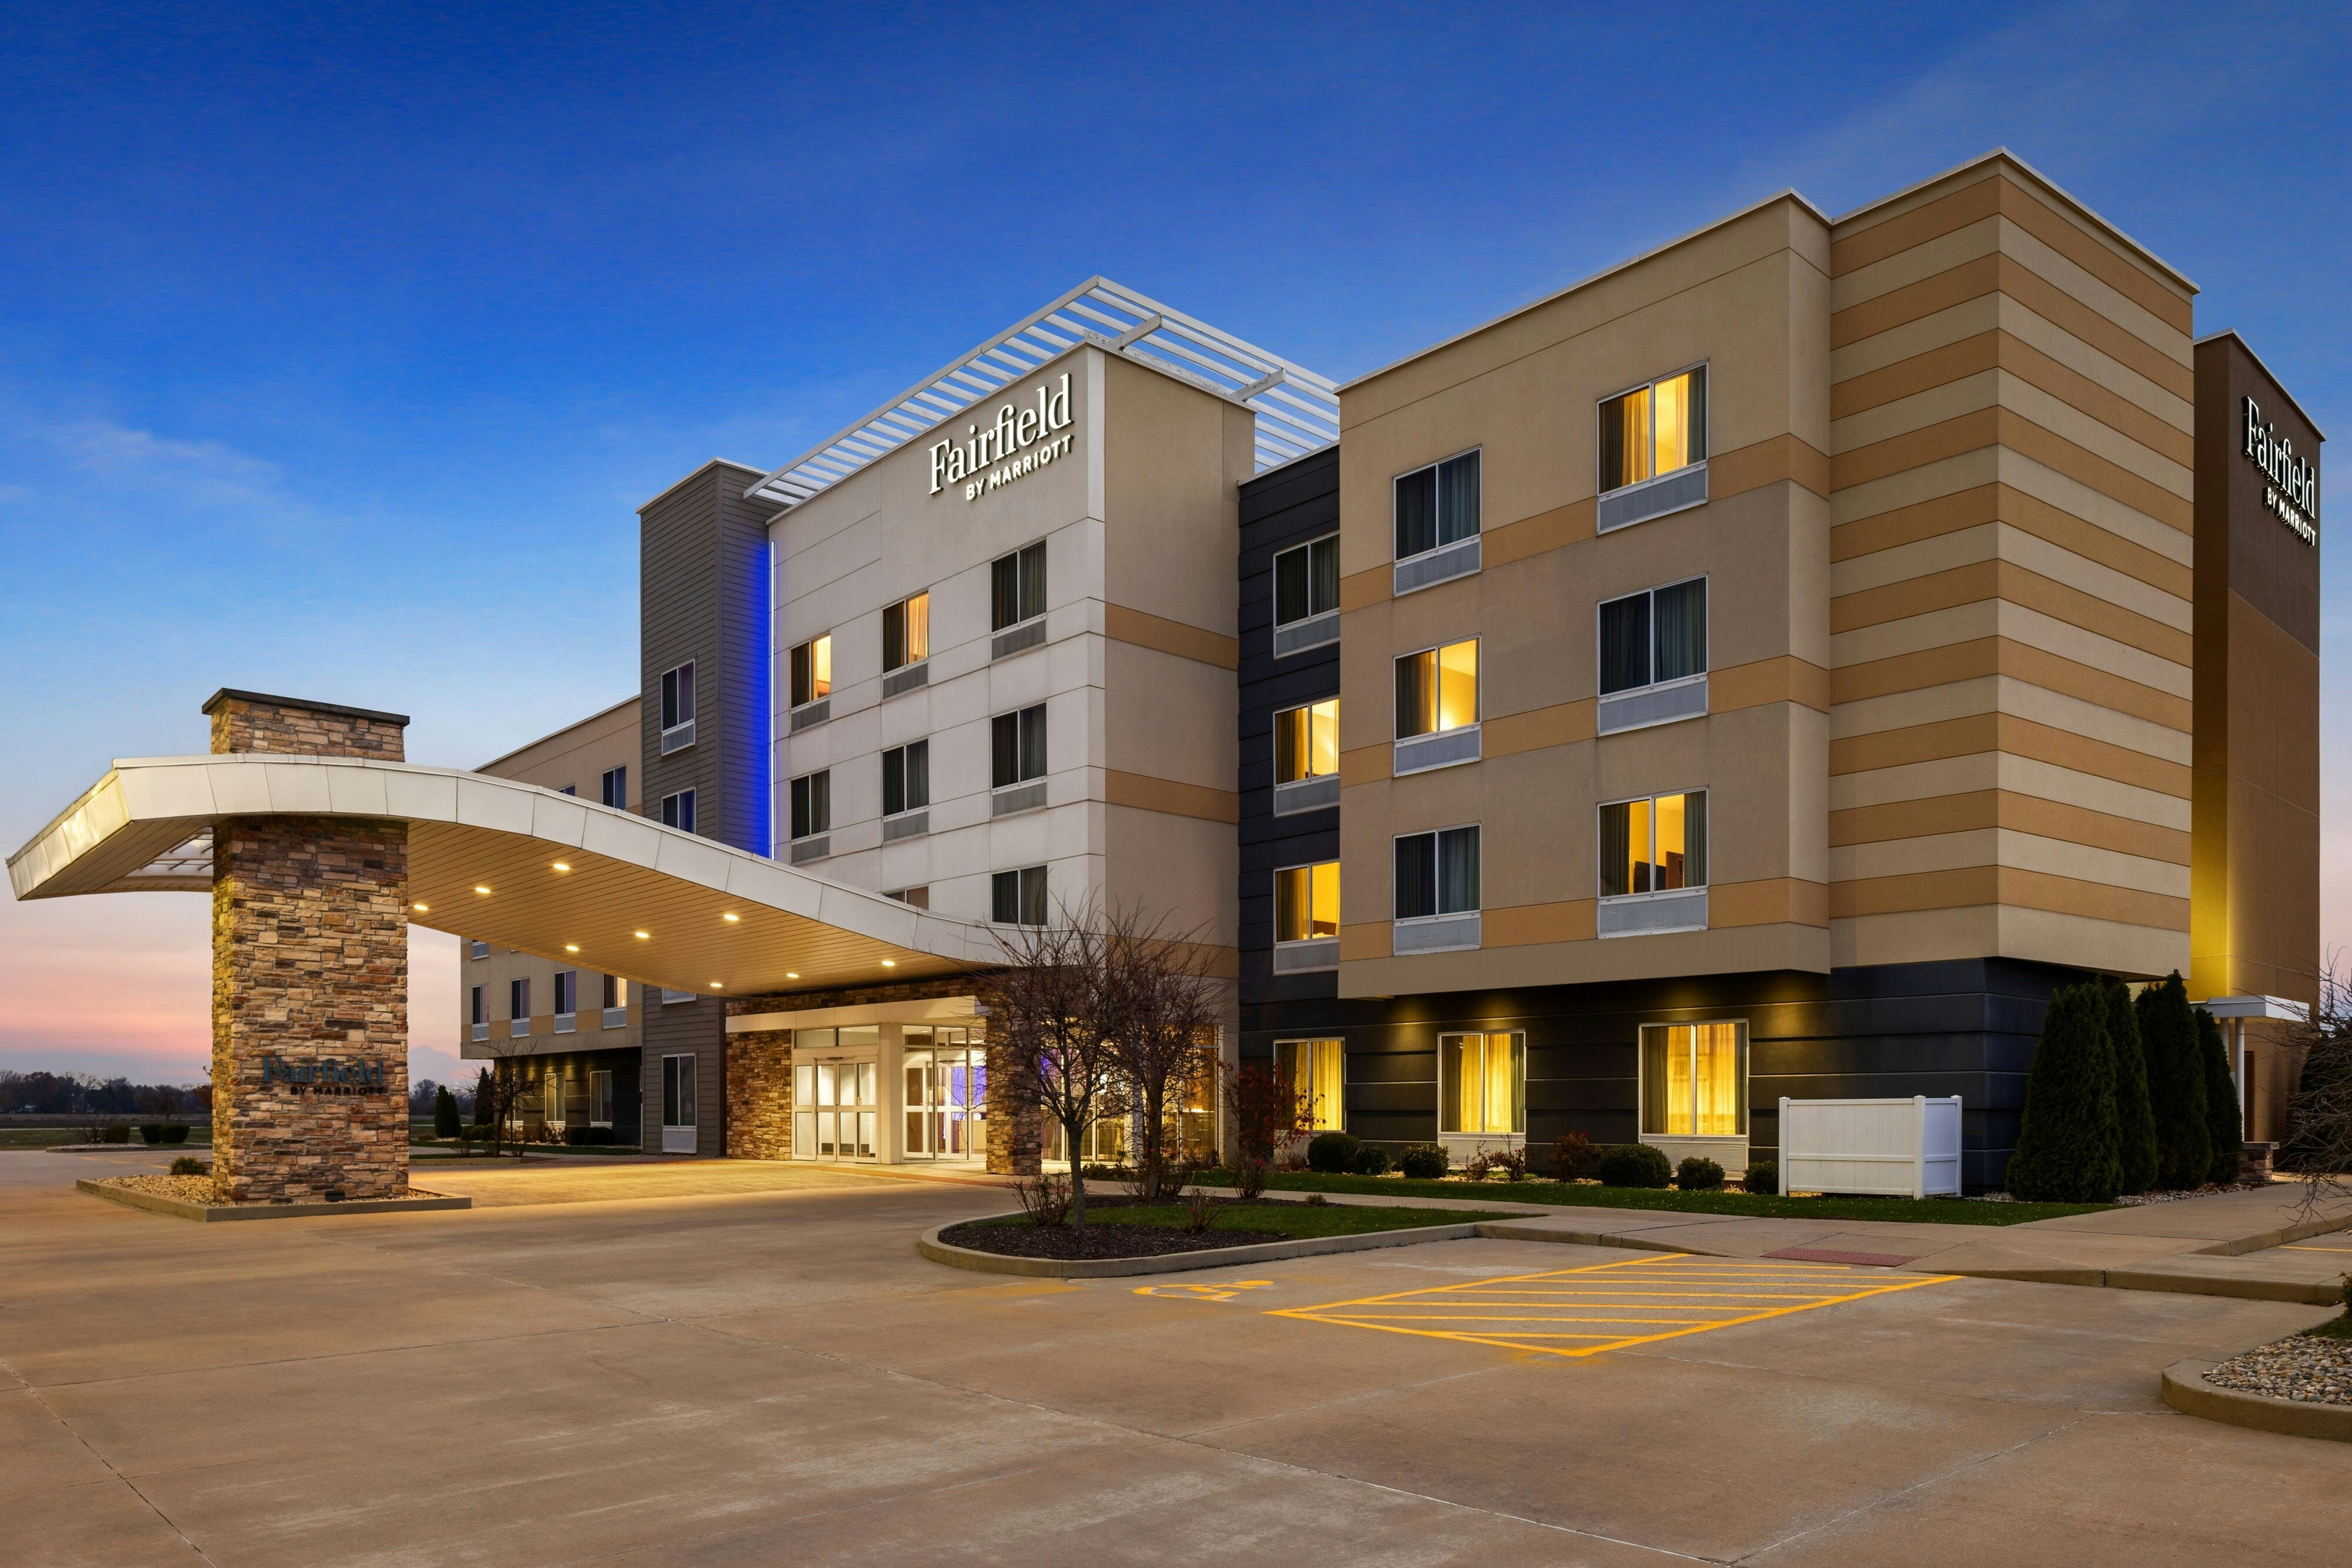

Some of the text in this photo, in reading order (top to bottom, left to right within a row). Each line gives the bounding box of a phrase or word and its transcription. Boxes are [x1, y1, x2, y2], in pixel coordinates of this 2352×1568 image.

[929, 373, 1073, 495] Fairfield
[2246, 395, 2316, 520] Fairfield
[966, 434, 1073, 500] BY MARRIOTT
[2267, 486, 2316, 547] BY MARRIOTT
[263, 1057, 383, 1084] Fairfield
[290, 1086, 307, 1095] BY
